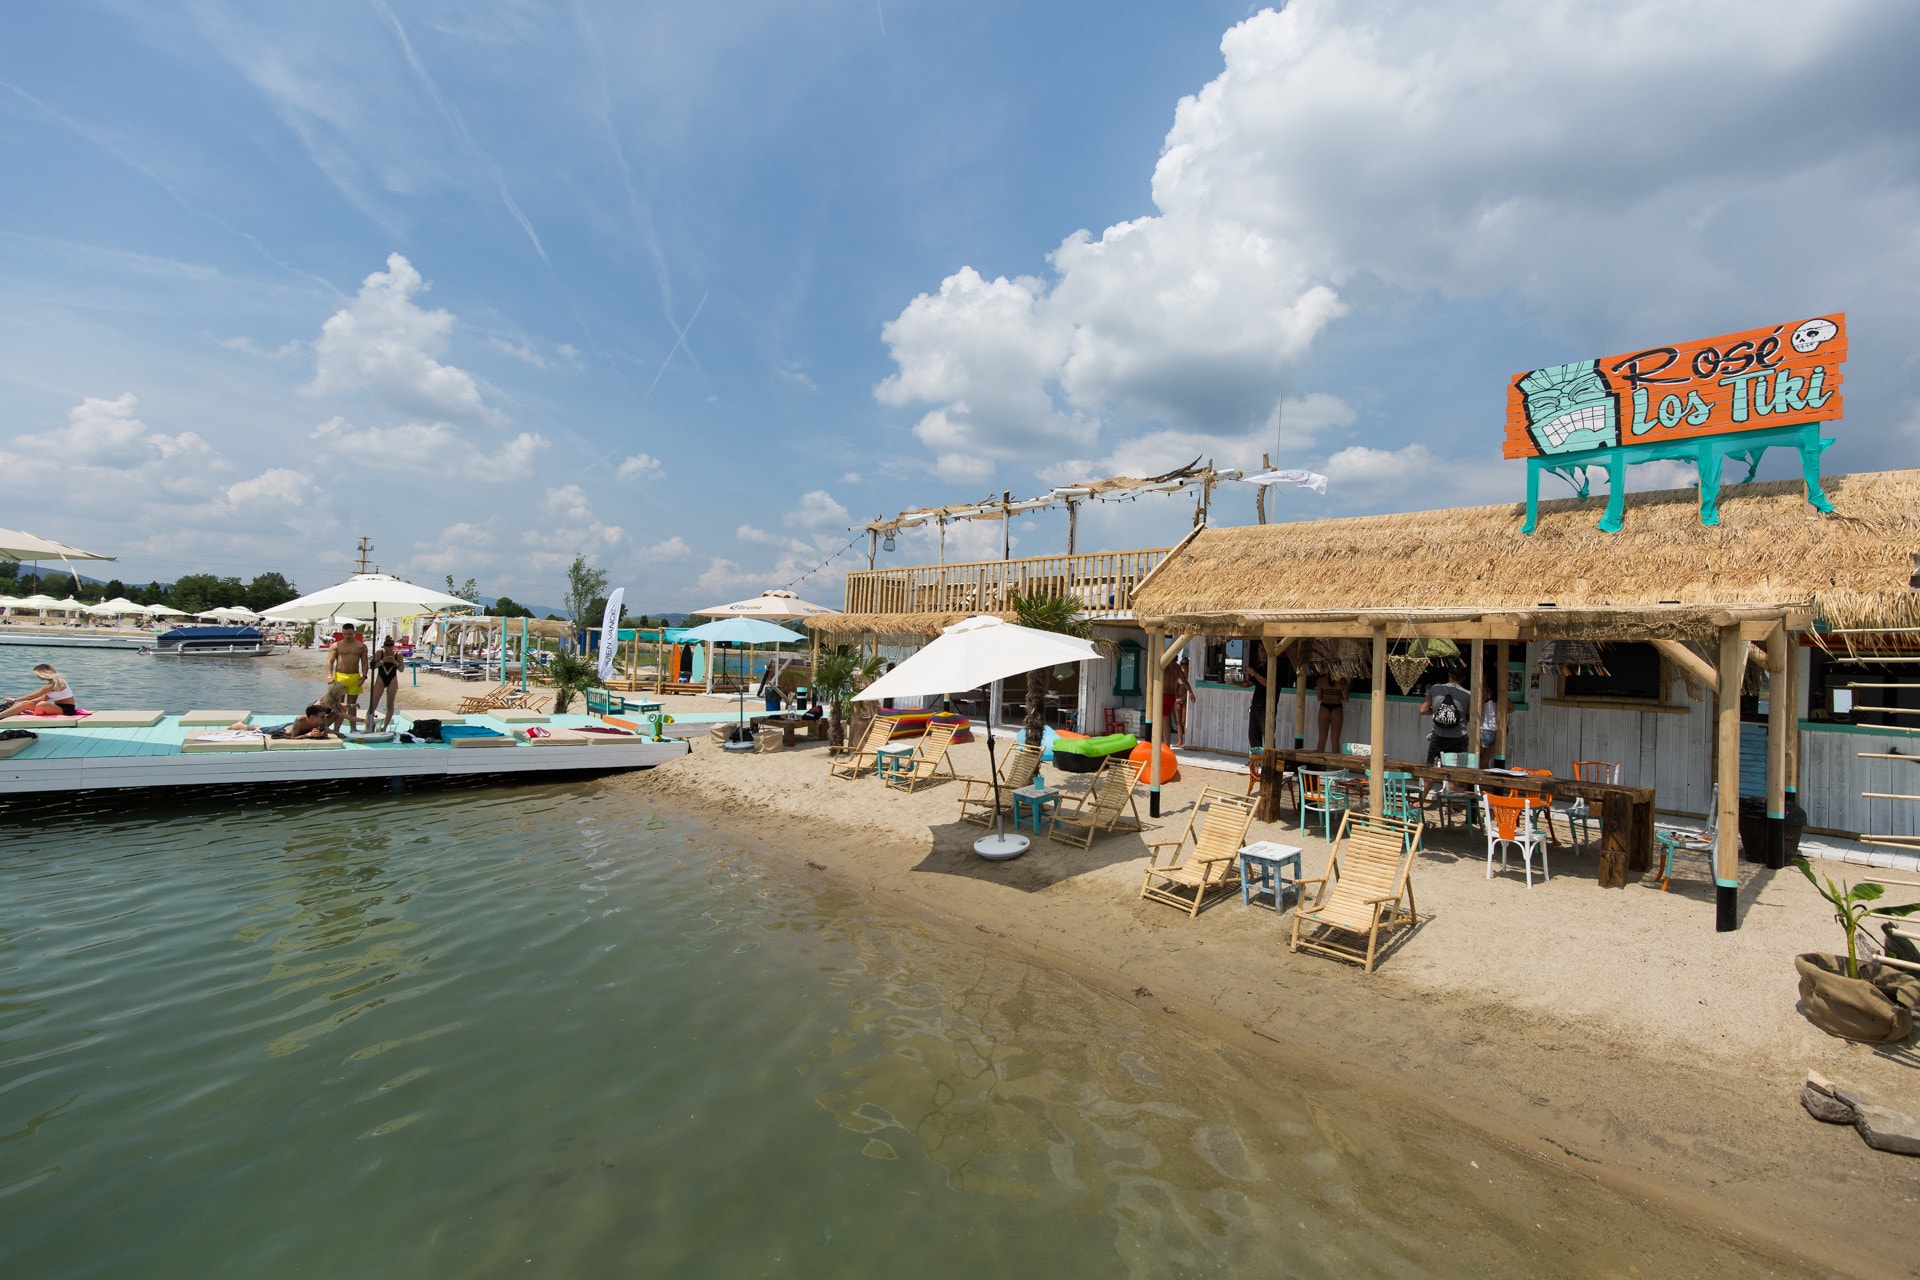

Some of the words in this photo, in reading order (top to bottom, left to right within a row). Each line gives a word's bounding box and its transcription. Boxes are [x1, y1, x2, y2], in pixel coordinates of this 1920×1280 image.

[1611, 325, 1785, 390] Rosé
[1631, 387, 1715, 436] Los
[1718, 366, 1834, 422] Tiki
